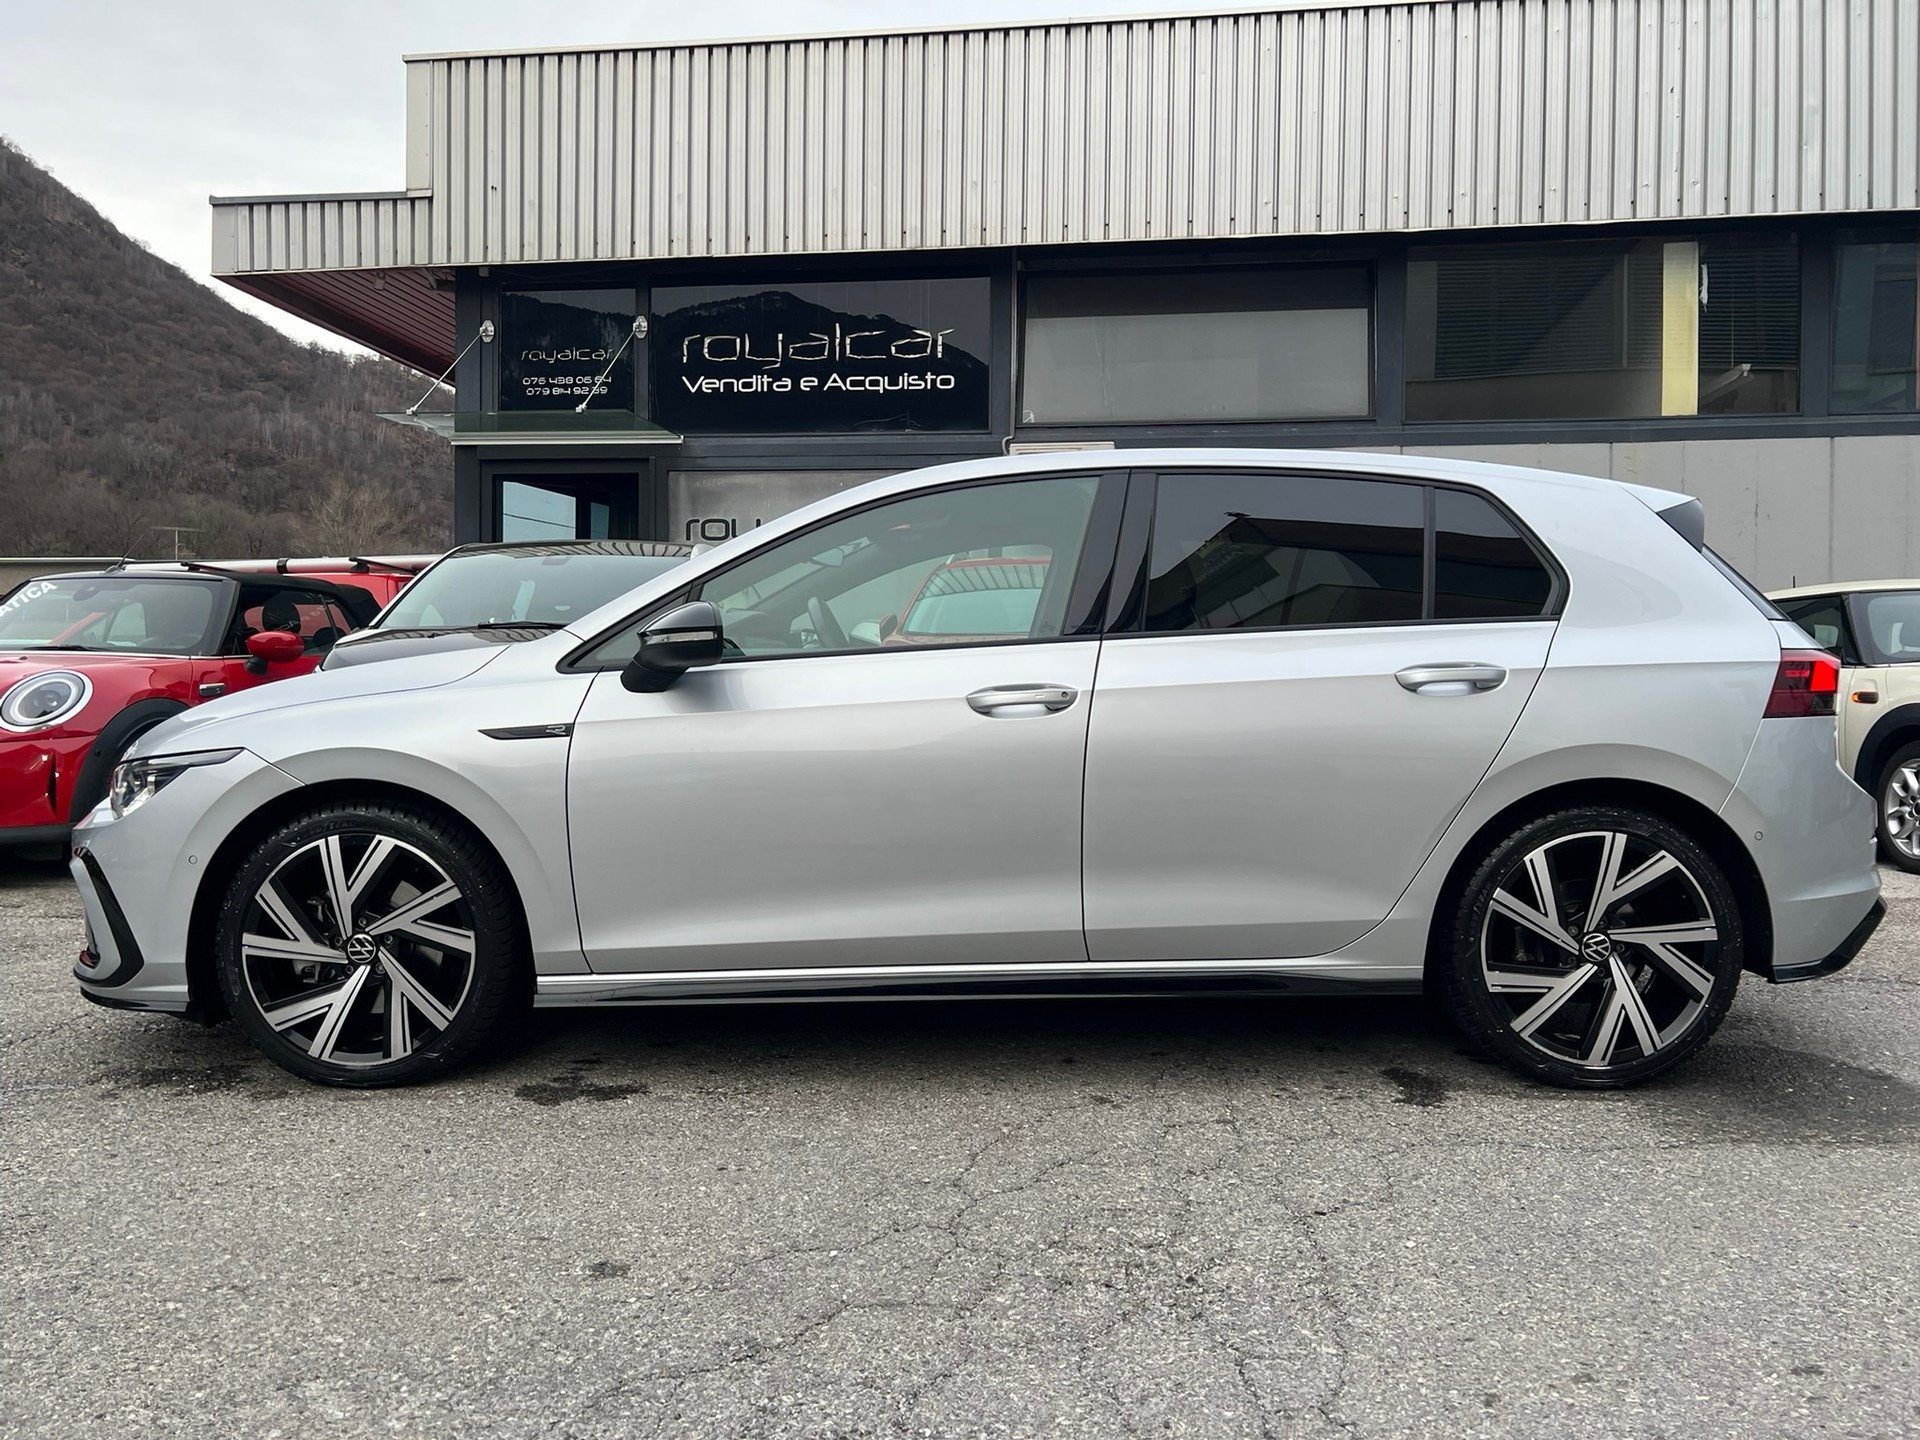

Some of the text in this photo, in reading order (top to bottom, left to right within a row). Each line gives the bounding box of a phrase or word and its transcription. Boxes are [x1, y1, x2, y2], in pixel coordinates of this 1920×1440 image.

[521, 346, 614, 364] royalcar
[683, 322, 956, 370] royalcar
[548, 376, 574, 385] 438
[575, 376, 593, 384] 06
[681, 372, 956, 394] Vendita e Acquisto
[526, 387, 550, 396] 079
[552, 387, 571, 395] 814
[573, 387, 590, 395] 92
